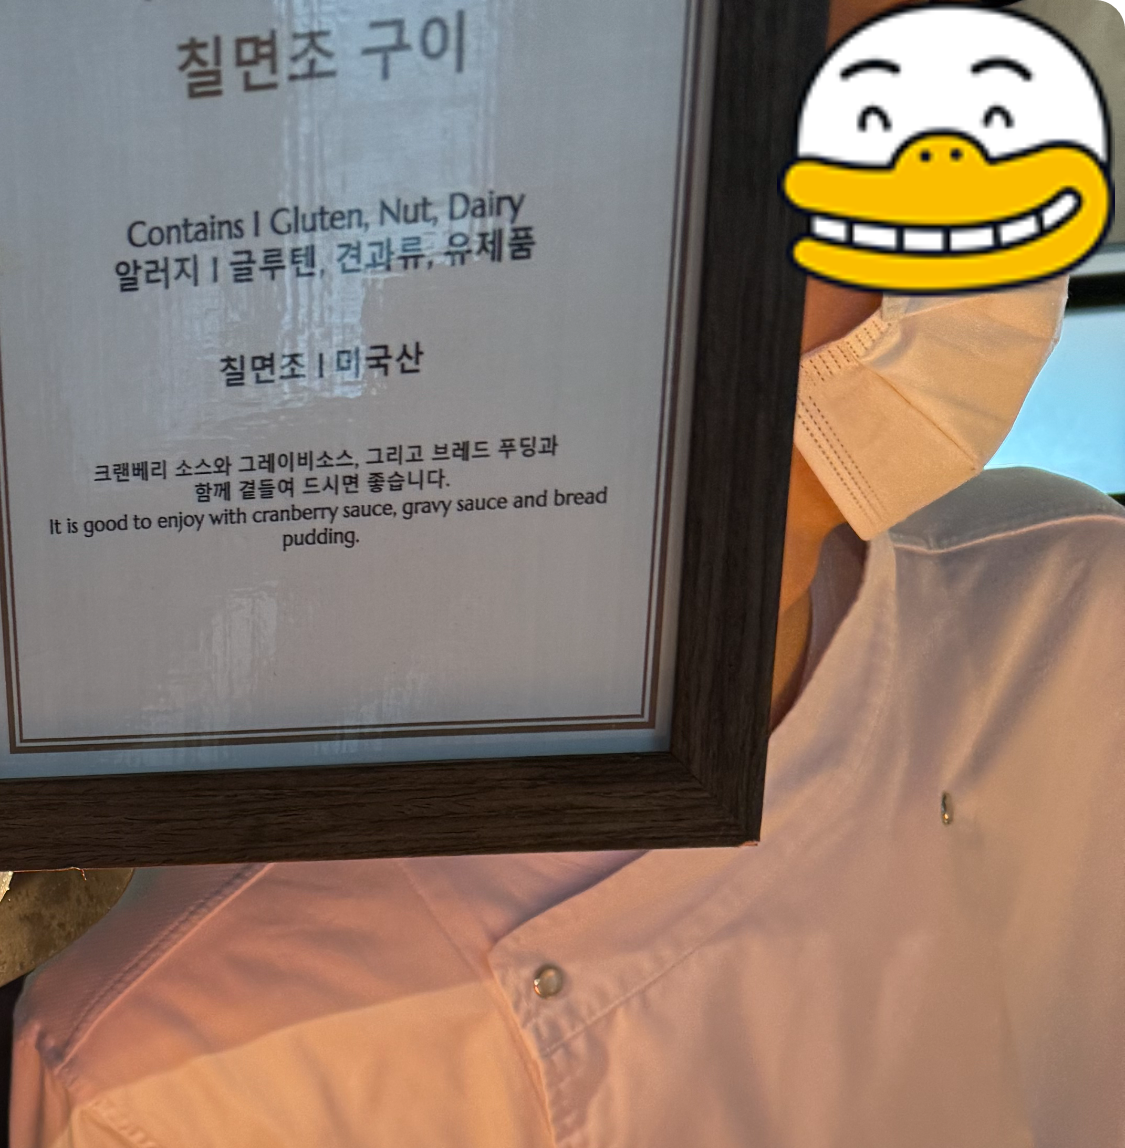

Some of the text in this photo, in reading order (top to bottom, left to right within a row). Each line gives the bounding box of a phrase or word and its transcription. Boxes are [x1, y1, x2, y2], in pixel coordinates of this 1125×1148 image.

[178, 10, 465, 99] 칠면조 구이
[127, 215, 245, 248] Contains
[270, 206, 368, 235] Gluten,
[380, 197, 437, 225] Nut,
[449, 192, 525, 223] Dairy
[115, 255, 198, 292] 알러지
[230, 245, 324, 283] 글루텐,
[337, 237, 433, 273] 견과류,
[444, 227, 535, 266] 유제품
[220, 353, 305, 387] 칠면조
[337, 342, 424, 376] 미국산
[94, 435, 558, 482] 크랜베리 소스와 그레이비소스, 그리고 브레드 푸딩과
[195, 469, 449, 502] 함께 곁들여 드시면 좋습니다.
[50, 486, 607, 537] It is good to enjoy with cranberry sauce, gravy sauce and bread
[283, 527, 359, 551] pudding.
